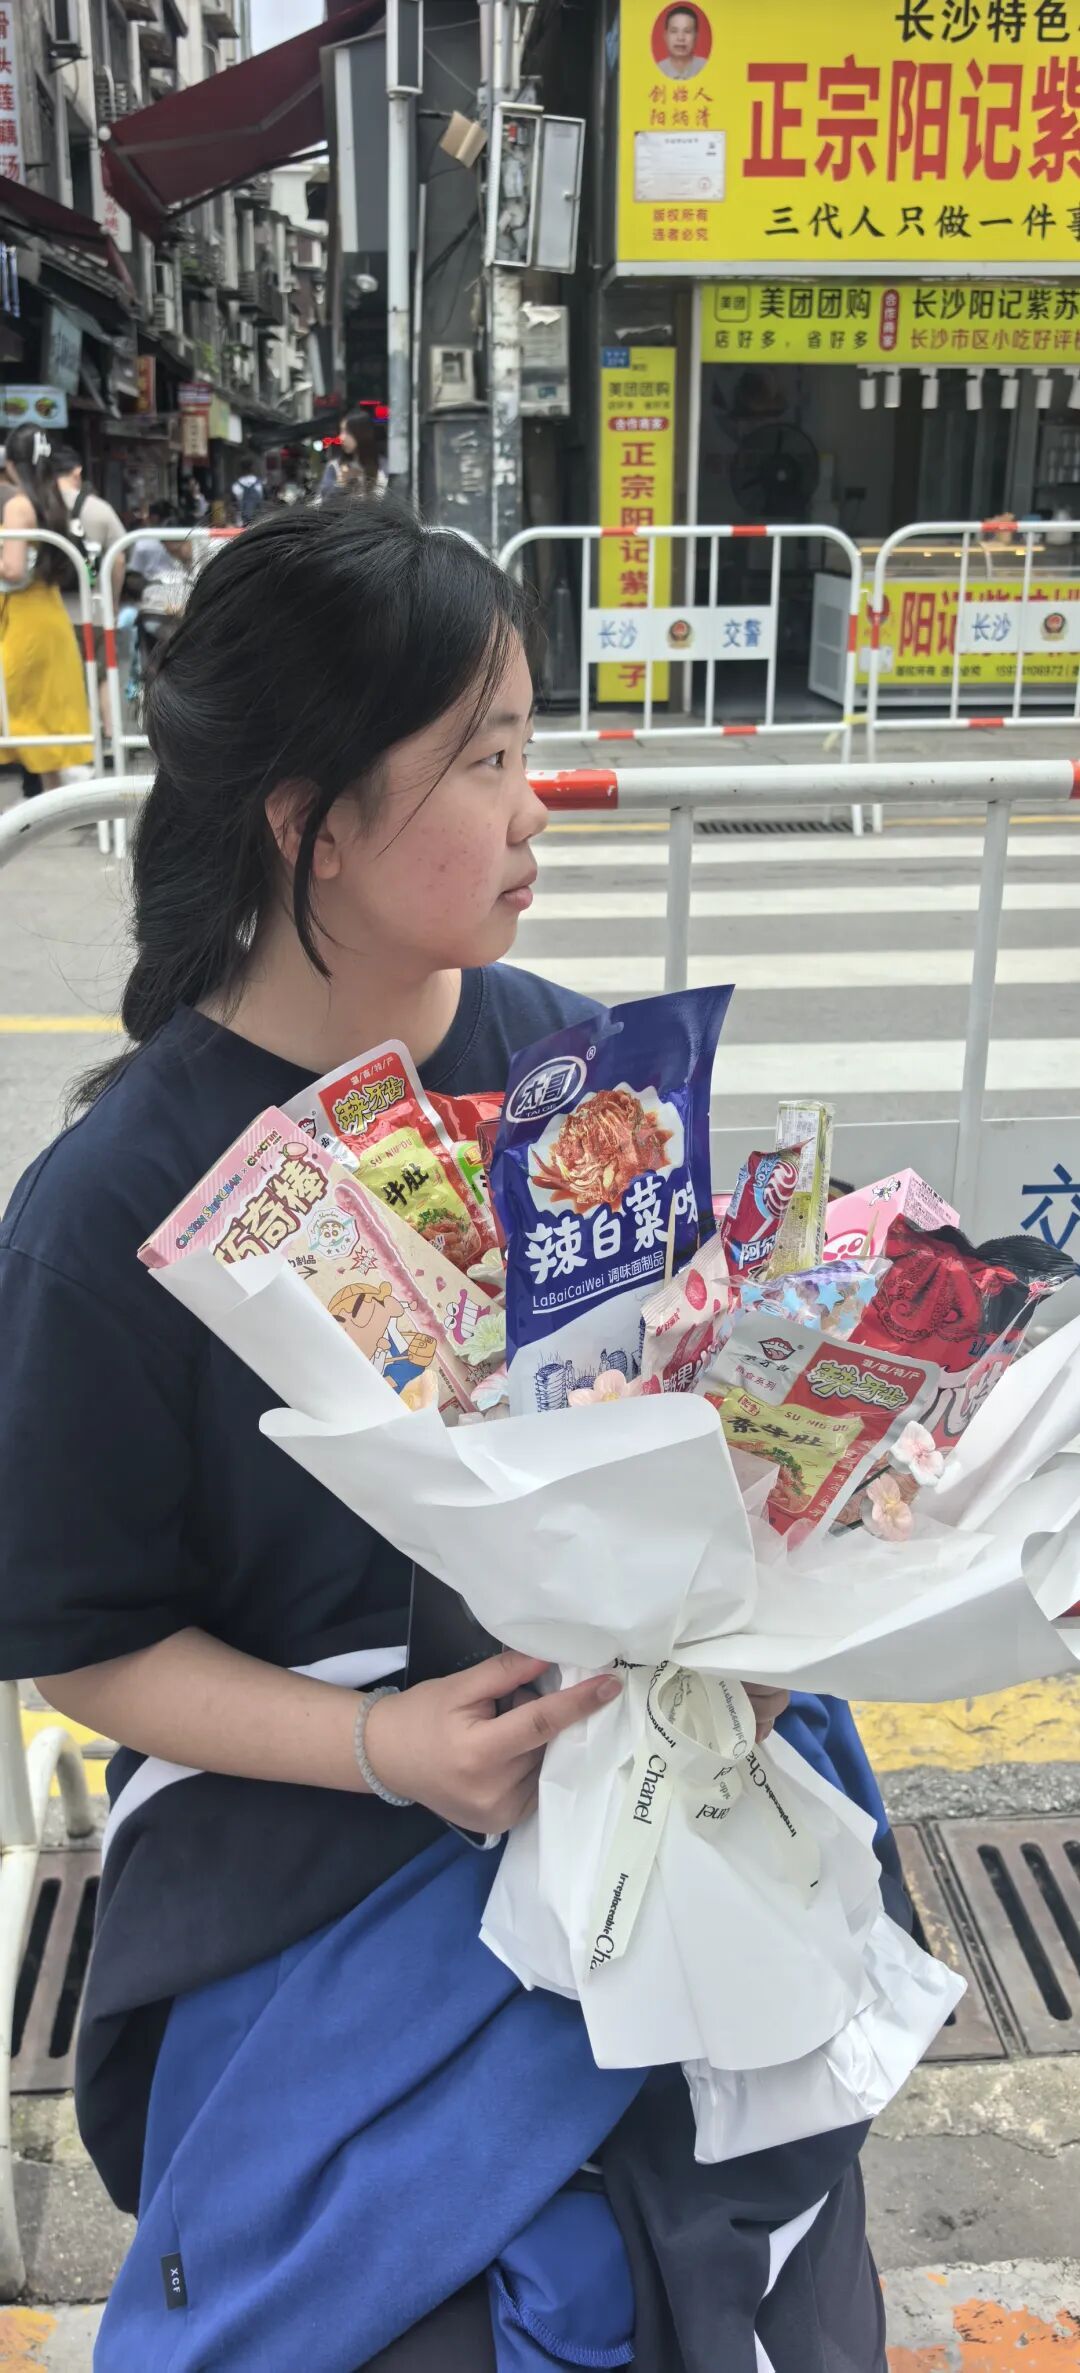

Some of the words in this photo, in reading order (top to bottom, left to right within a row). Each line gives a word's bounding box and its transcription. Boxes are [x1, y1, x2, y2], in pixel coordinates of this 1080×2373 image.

[649, 85, 713, 104] 创始人
[743, 55, 1080, 183] 正宗阳记紫
[653, 209, 708, 222] 版权所有
[653, 228, 709, 241] 违者必究
[760, 288, 872, 319] 美团团购
[912, 289, 1080, 320] 长沙阳记紫苏
[881, 291, 898, 348] 合作商家
[910, 329, 1080, 350] 长沙市区小吃好评
[608, 381, 671, 398] 美团团购
[615, 418, 664, 431] 合作商家
[598, 619, 637, 649] 长沙
[723, 619, 761, 648] 交警
[972, 612, 1011, 641] 长沙
[175, 1214, 208, 1250] CRAYON
[525, 1175, 699, 1285] 辣白菜味
[532, 1274, 605, 1308] LaBaiCaiWei
[608, 1250, 665, 1284] 调味面制品
[784, 1411, 801, 1421] SU
[632, 1753, 668, 1826] Chanel
[603, 1872, 630, 1935] Irreplaceable
[170, 2267, 181, 2293] XCF
